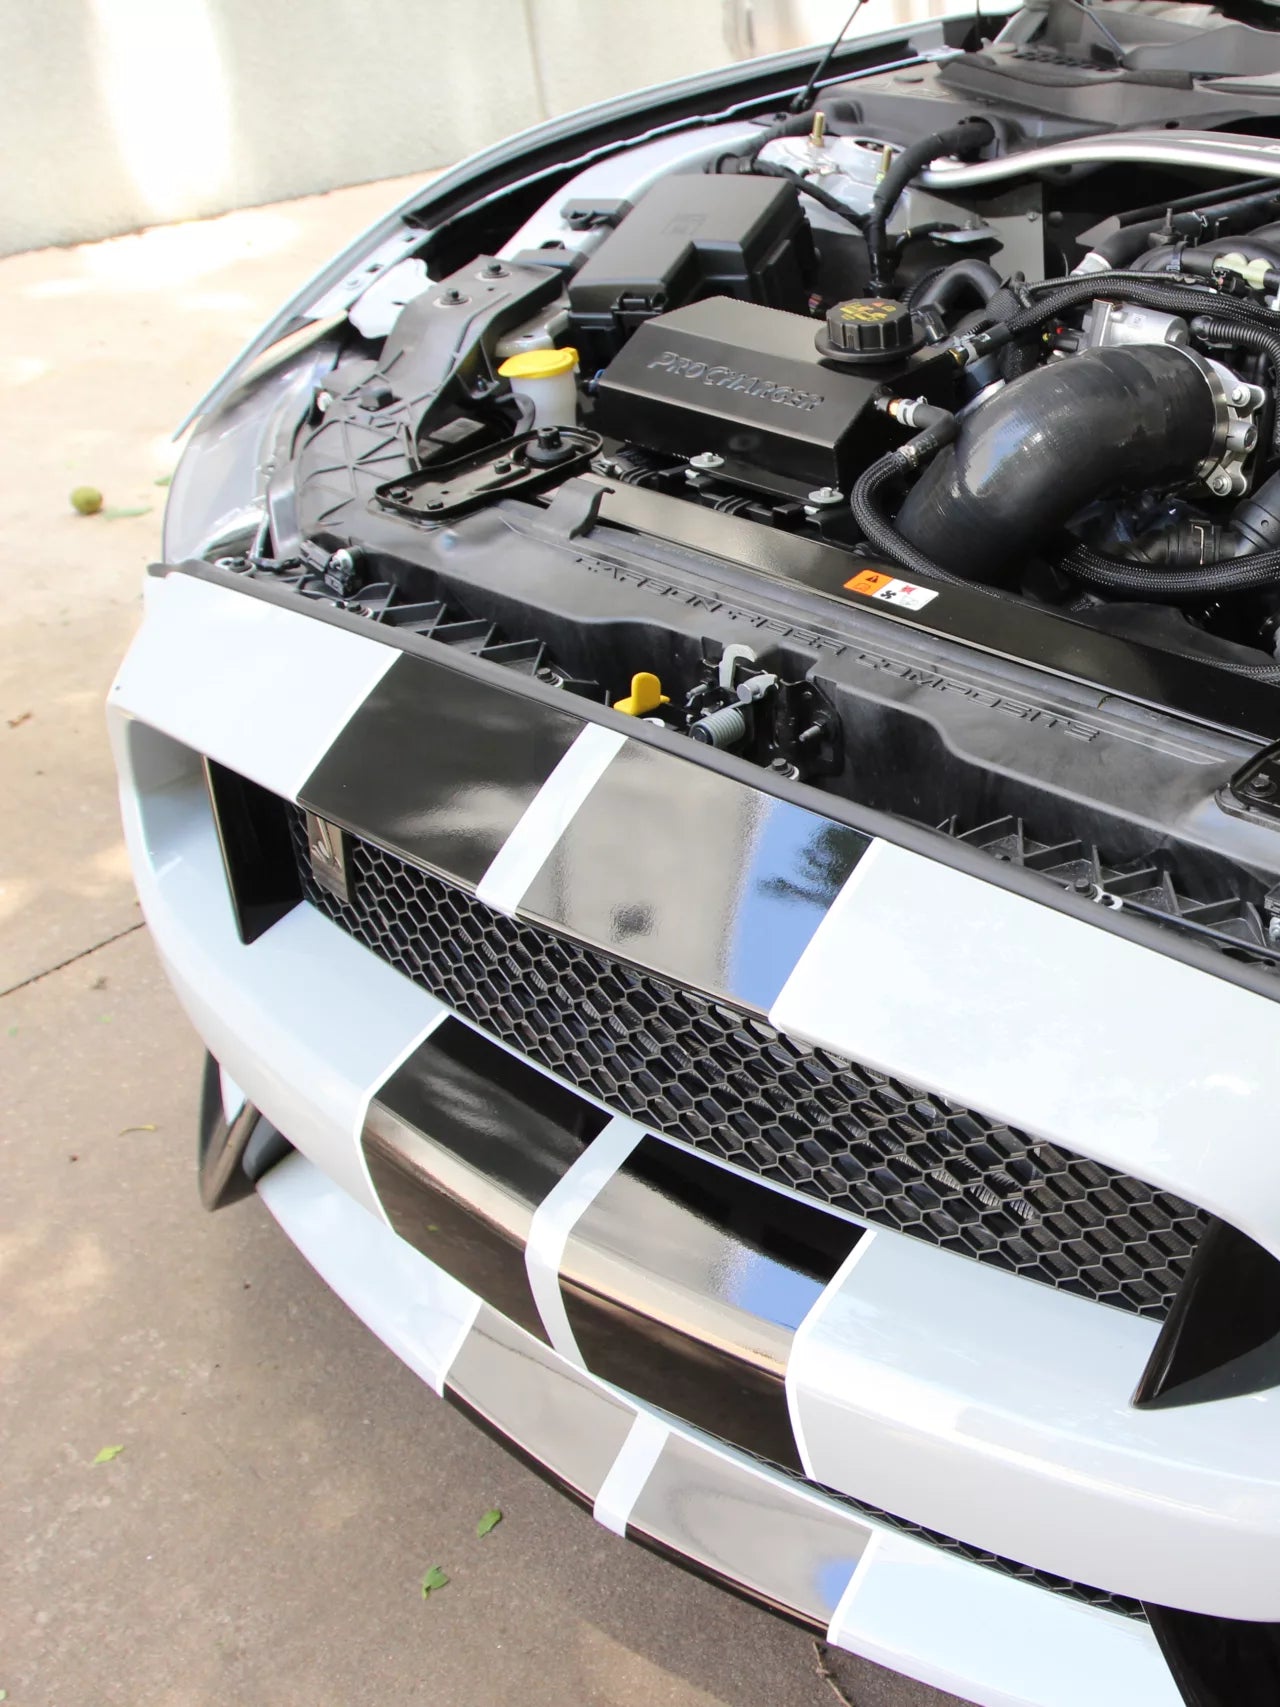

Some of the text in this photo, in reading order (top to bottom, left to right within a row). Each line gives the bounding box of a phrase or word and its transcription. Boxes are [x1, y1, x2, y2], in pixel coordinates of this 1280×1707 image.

[647, 351, 825, 411] PROCHARGER
[575, 556, 723, 613] CARBON
[855, 653, 1101, 742] COMPOSITE
